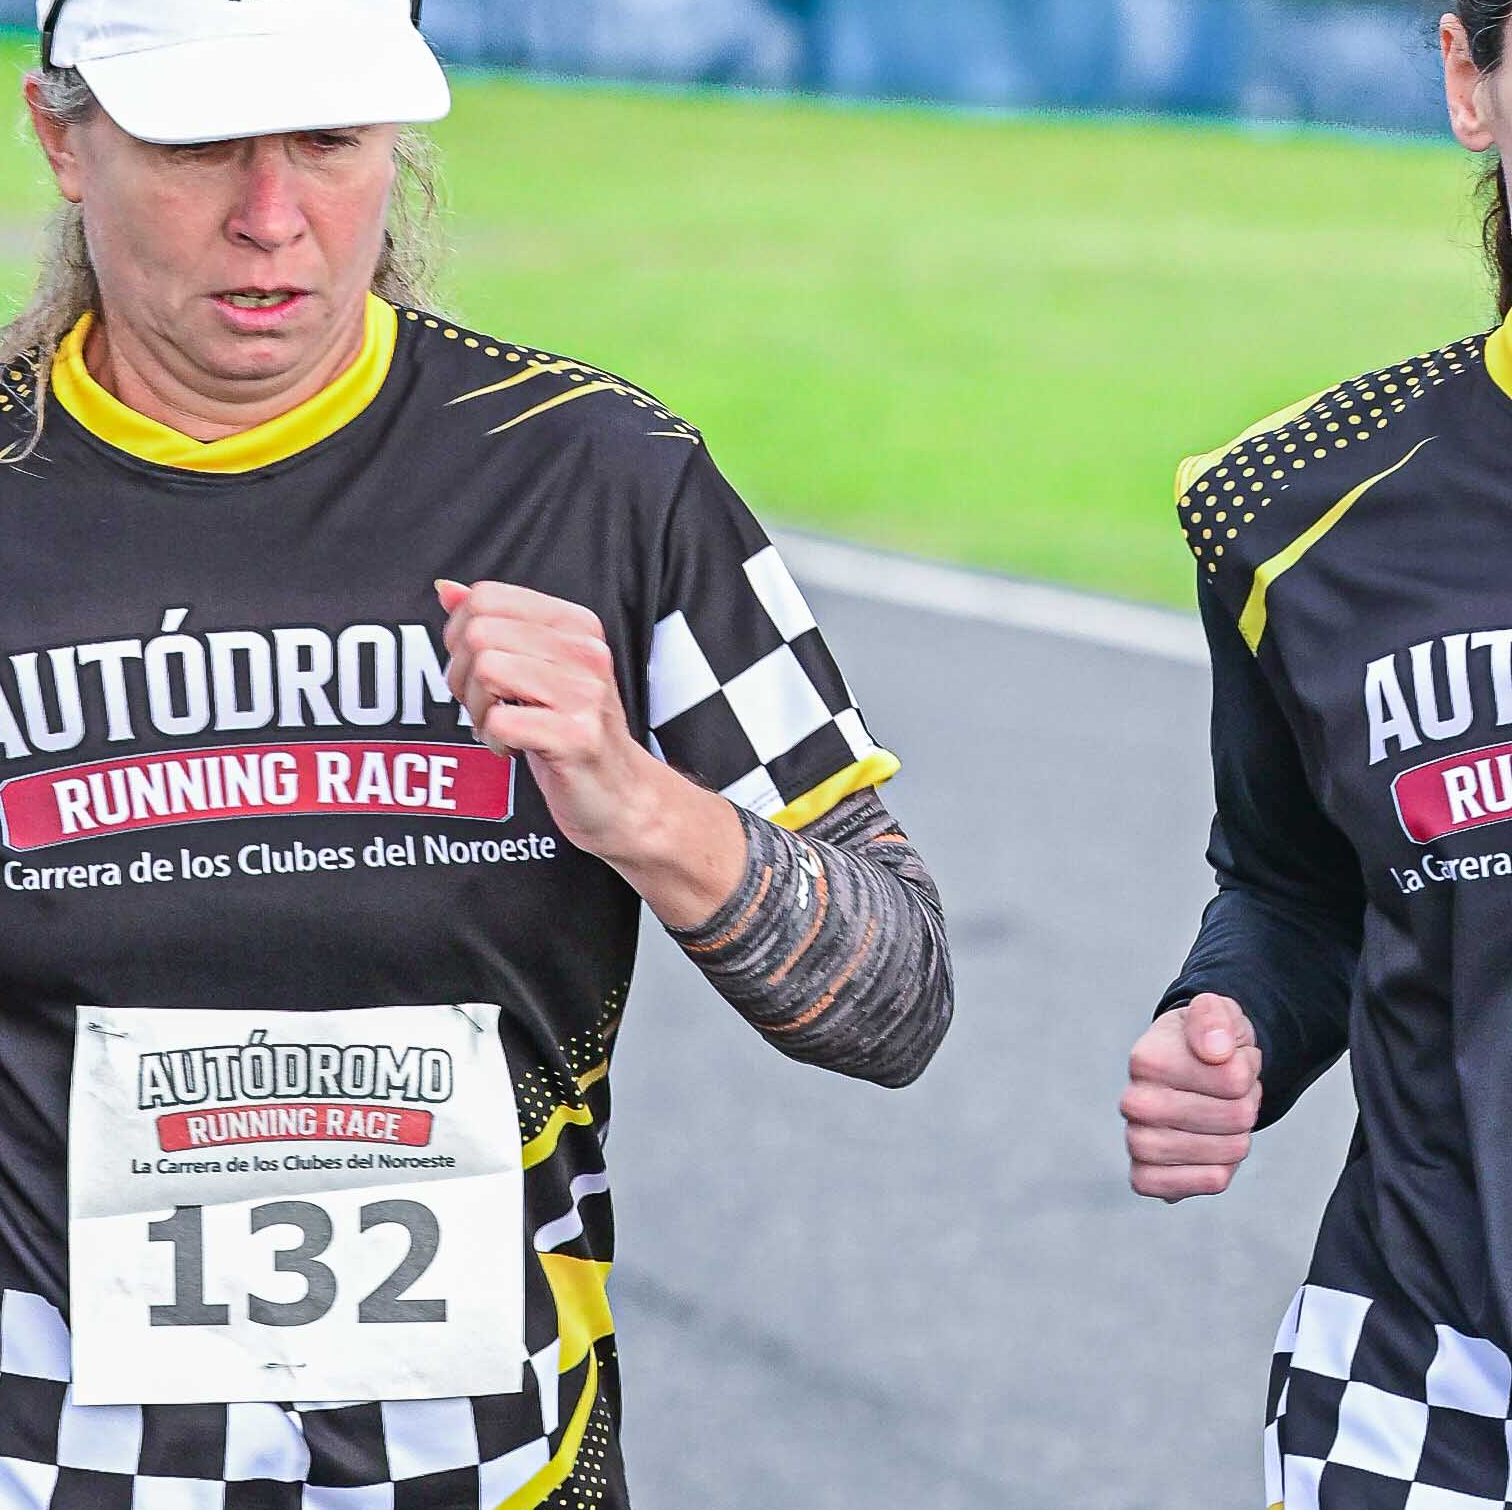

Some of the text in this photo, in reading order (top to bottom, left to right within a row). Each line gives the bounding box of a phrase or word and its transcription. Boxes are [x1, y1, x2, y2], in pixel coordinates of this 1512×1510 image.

[50, 750, 459, 836] RUNNING RACE
[3, 860, 122, 891] Carrera
[129, 851, 174, 883] de
[180, 848, 232, 879] los
[237, 841, 356, 876] Clubes
[362, 836, 417, 867] del
[423, 832, 557, 865] Noroeste
[138, 1030, 453, 1110] AUTÓDROMO
[187, 1107, 402, 1147] RUNNING RACE
[131, 1153, 456, 1174] La Carrera de los Clubes del Noroeste
[148, 1199, 447, 1327] 132
